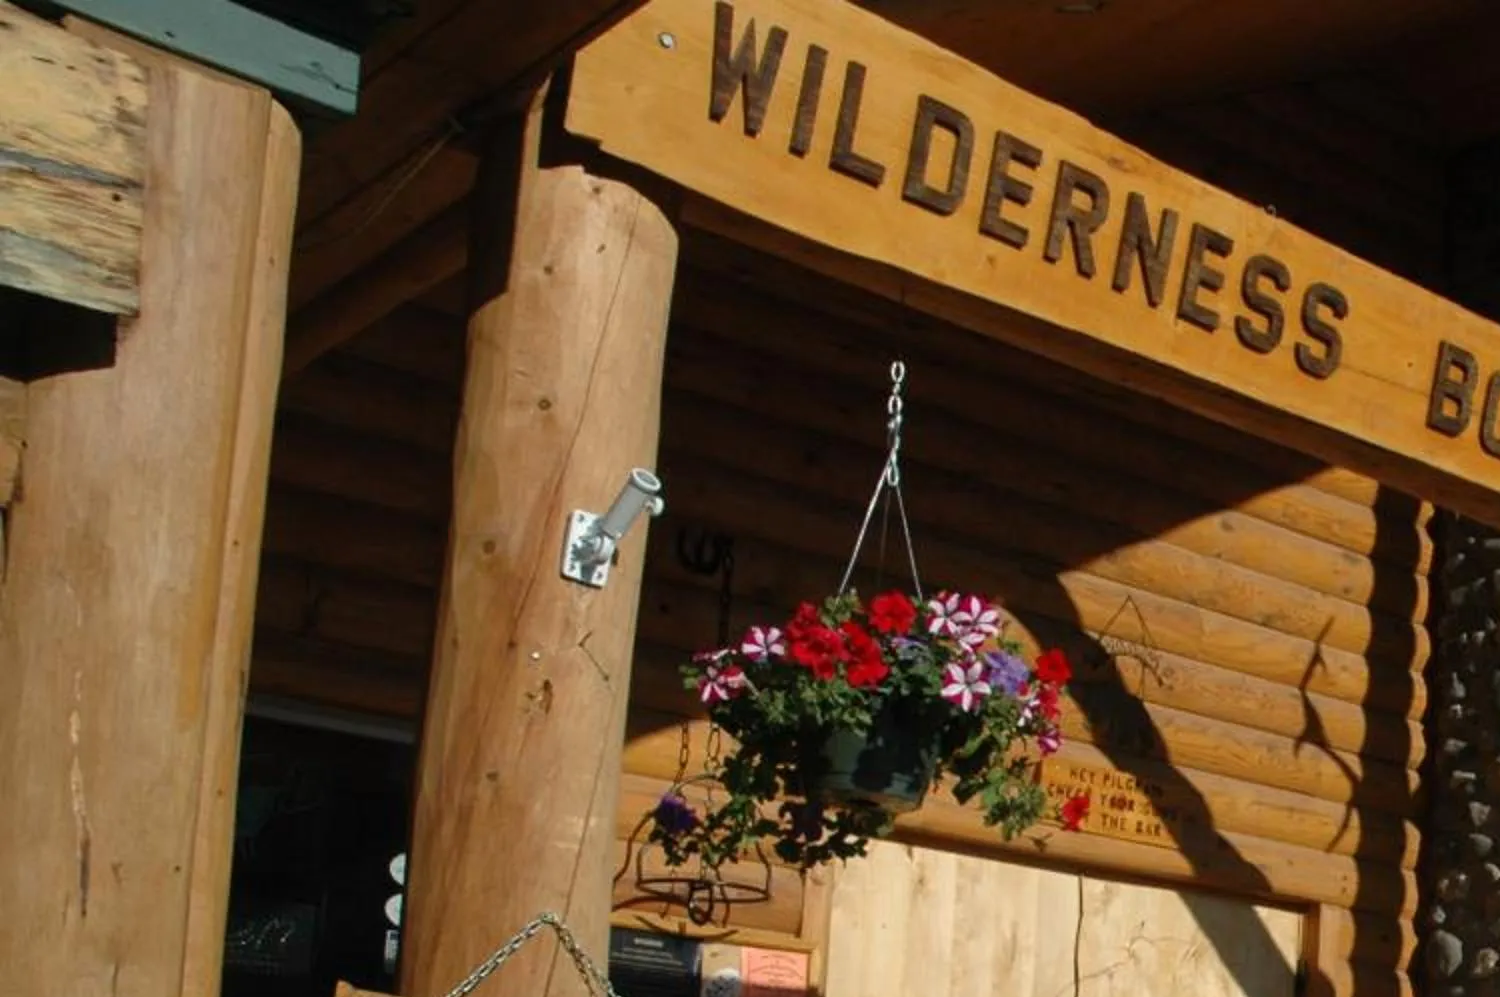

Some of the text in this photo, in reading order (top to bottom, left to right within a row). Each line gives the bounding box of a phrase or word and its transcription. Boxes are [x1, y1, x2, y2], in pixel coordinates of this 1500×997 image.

[708, 1, 1349, 381] WILDERNESS
[1070, 768, 1095, 784] HEY
[1101, 813, 1127, 831] THE
